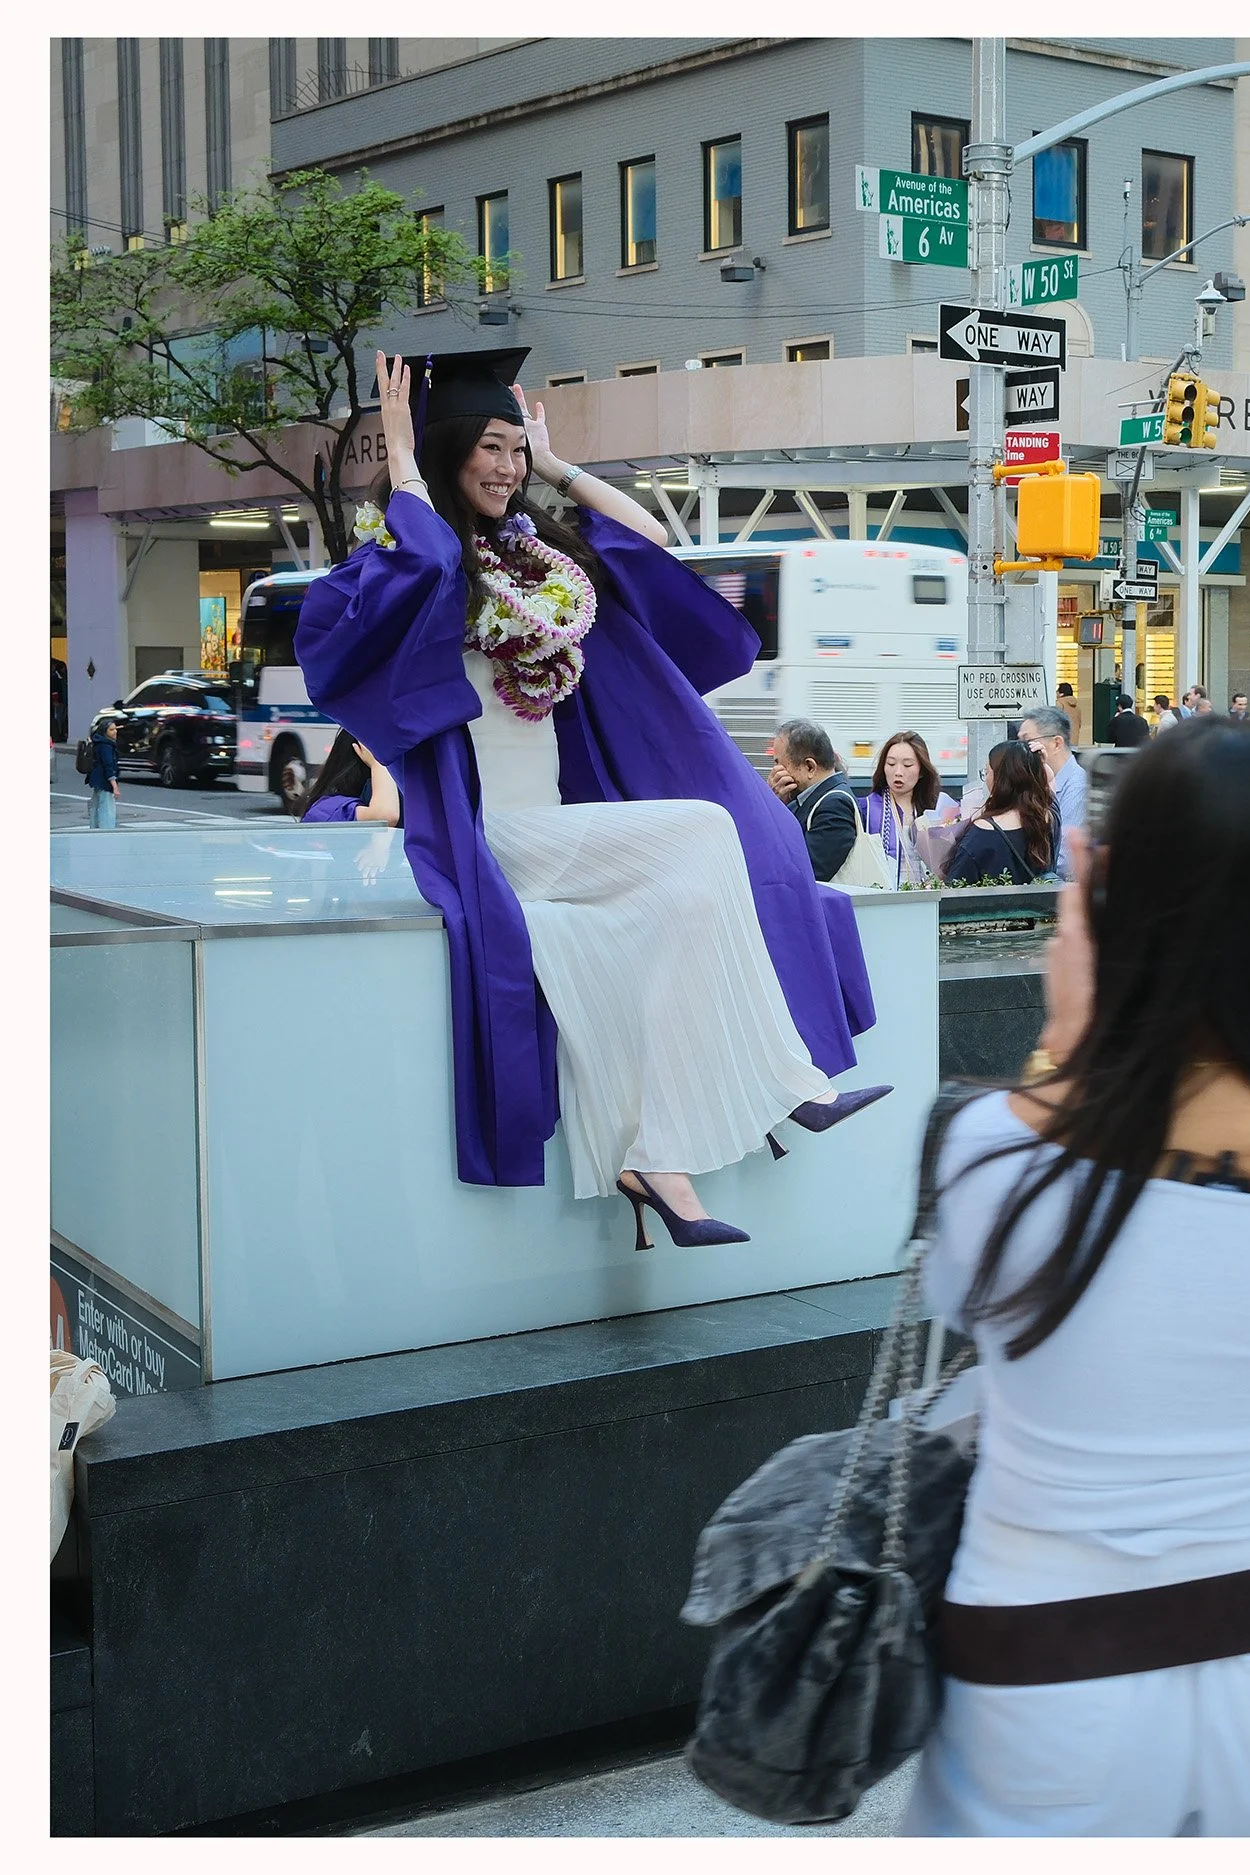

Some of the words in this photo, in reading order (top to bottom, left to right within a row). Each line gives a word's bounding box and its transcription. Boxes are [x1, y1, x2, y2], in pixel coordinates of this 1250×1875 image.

[895, 176, 926, 191] Avenue
[928, 182, 937, 193] of
[939, 182, 952, 195] the
[887, 189, 960, 219] Americas
[918, 226, 930, 258] 6
[939, 226, 954, 246] Av
[1024, 267, 1036, 300] W
[1040, 264, 1059, 298] 50
[1063, 259, 1074, 279] St
[965, 324, 999, 348] ONE
[1017, 330, 1053, 354] WAY
[1016, 385, 1048, 408] WAY
[1143, 421, 1151, 439] W
[1117, 451, 1129, 459] THE
[1147, 516, 1173, 526] Americas
[1149, 528, 1154, 540] 6
[1109, 541, 1118, 554] 50
[1138, 564, 1153, 574] WAY
[1119, 587, 1133, 595] ONE
[1138, 587, 1153, 596] WAY
[963, 672, 975, 684] NO
[979, 672, 998, 684] PED.
[1000, 672, 1041, 684] CROSSING
[967, 688, 984, 699] USE
[988, 687, 1038, 699] CROSSWALK
[78, 1289, 105, 1335] Enter
[106, 1315, 129, 1354] with
[130, 1335, 142, 1363] or
[144, 1335, 165, 1388] buy
[79, 1325, 134, 1394] MetroCard
